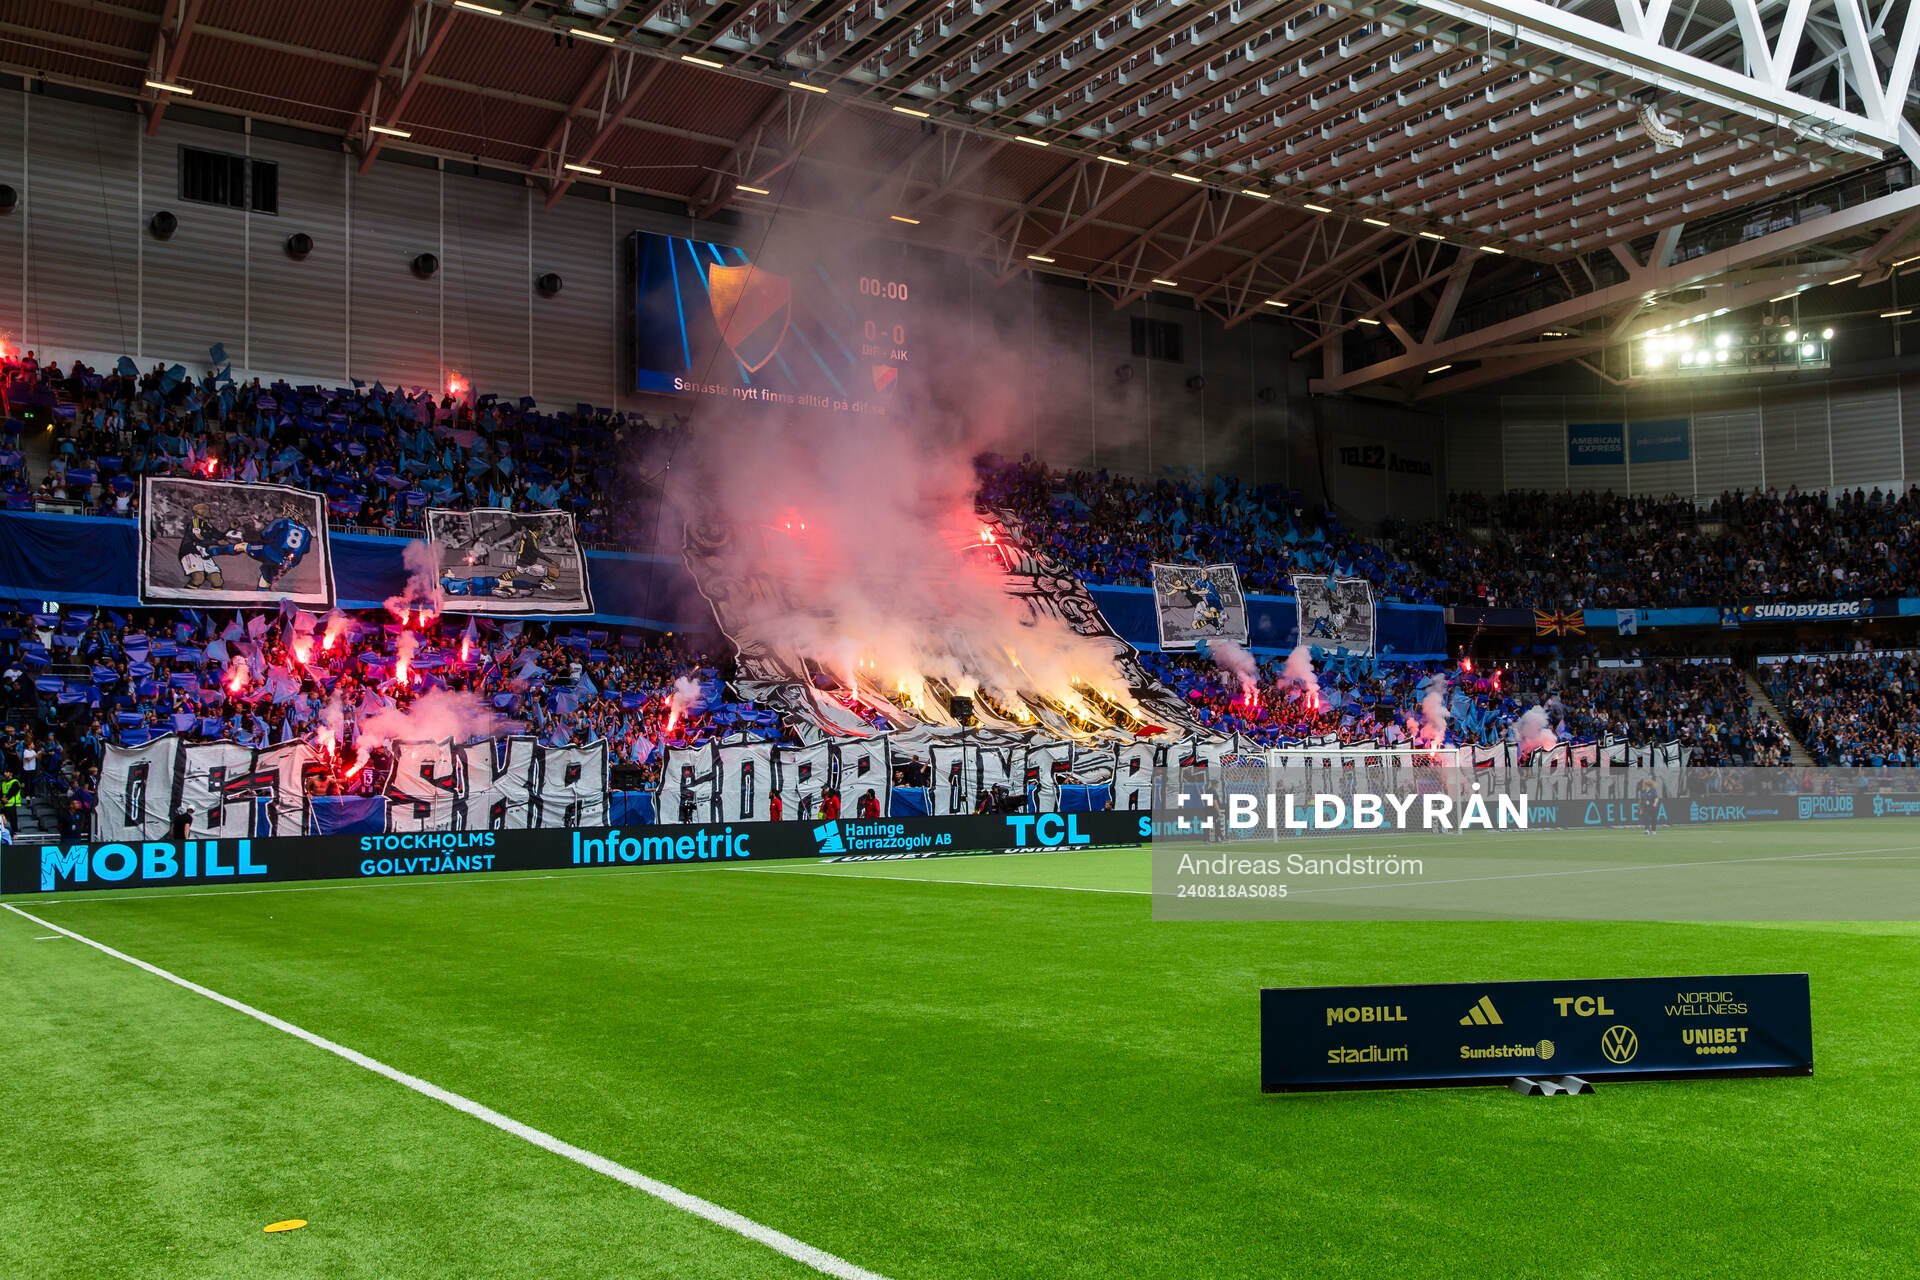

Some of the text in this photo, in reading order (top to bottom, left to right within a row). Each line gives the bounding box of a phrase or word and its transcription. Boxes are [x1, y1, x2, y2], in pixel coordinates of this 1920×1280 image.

[859, 276, 909, 301] 00:00
[864, 320, 876, 341] 0
[893, 325, 905, 346] 0
[890, 349, 909, 361] AIK
[674, 377, 729, 396] Senaste
[732, 386, 758, 401] nytt
[761, 388, 794, 405] finns
[798, 393, 829, 409] alltid
[833, 398, 849, 412] på
[1571, 437, 1621, 445] AMERICAN
[1578, 444, 1621, 453] EXPRESS
[1388, 453, 1433, 476] Arena
[287, 528, 302, 548] 8
[1754, 601, 1860, 618] SUNDBYBERG
[94, 732, 332, 842] DET
[383, 735, 612, 834] SKA
[1607, 802, 1668, 822] ELEA
[1699, 806, 1746, 821] STARK
[1812, 795, 1854, 812] PROJOB
[845, 822, 905, 838] Haninge
[1006, 813, 1091, 847] TCL
[360, 832, 496, 852] STOCKHOLMS
[572, 826, 751, 865] Infometric
[846, 833, 952, 851] Terrazzogolv AB
[1004, 844, 1083, 854] UNIBET
[40, 839, 268, 891] MOBILL
[360, 850, 496, 876] GOLVTJÄNST
[841, 851, 939, 863] UNIBET
[1553, 995, 1615, 1017] TCL
[1677, 991, 1733, 1004] NORDIC
[1326, 1005, 1408, 1026] MOBILL
[1664, 1003, 1748, 1017] WELLNESS
[1682, 1027, 1749, 1045] UNIBET
[1327, 1044, 1409, 1064] stadium
[1460, 1044, 1536, 1060] Sundström
